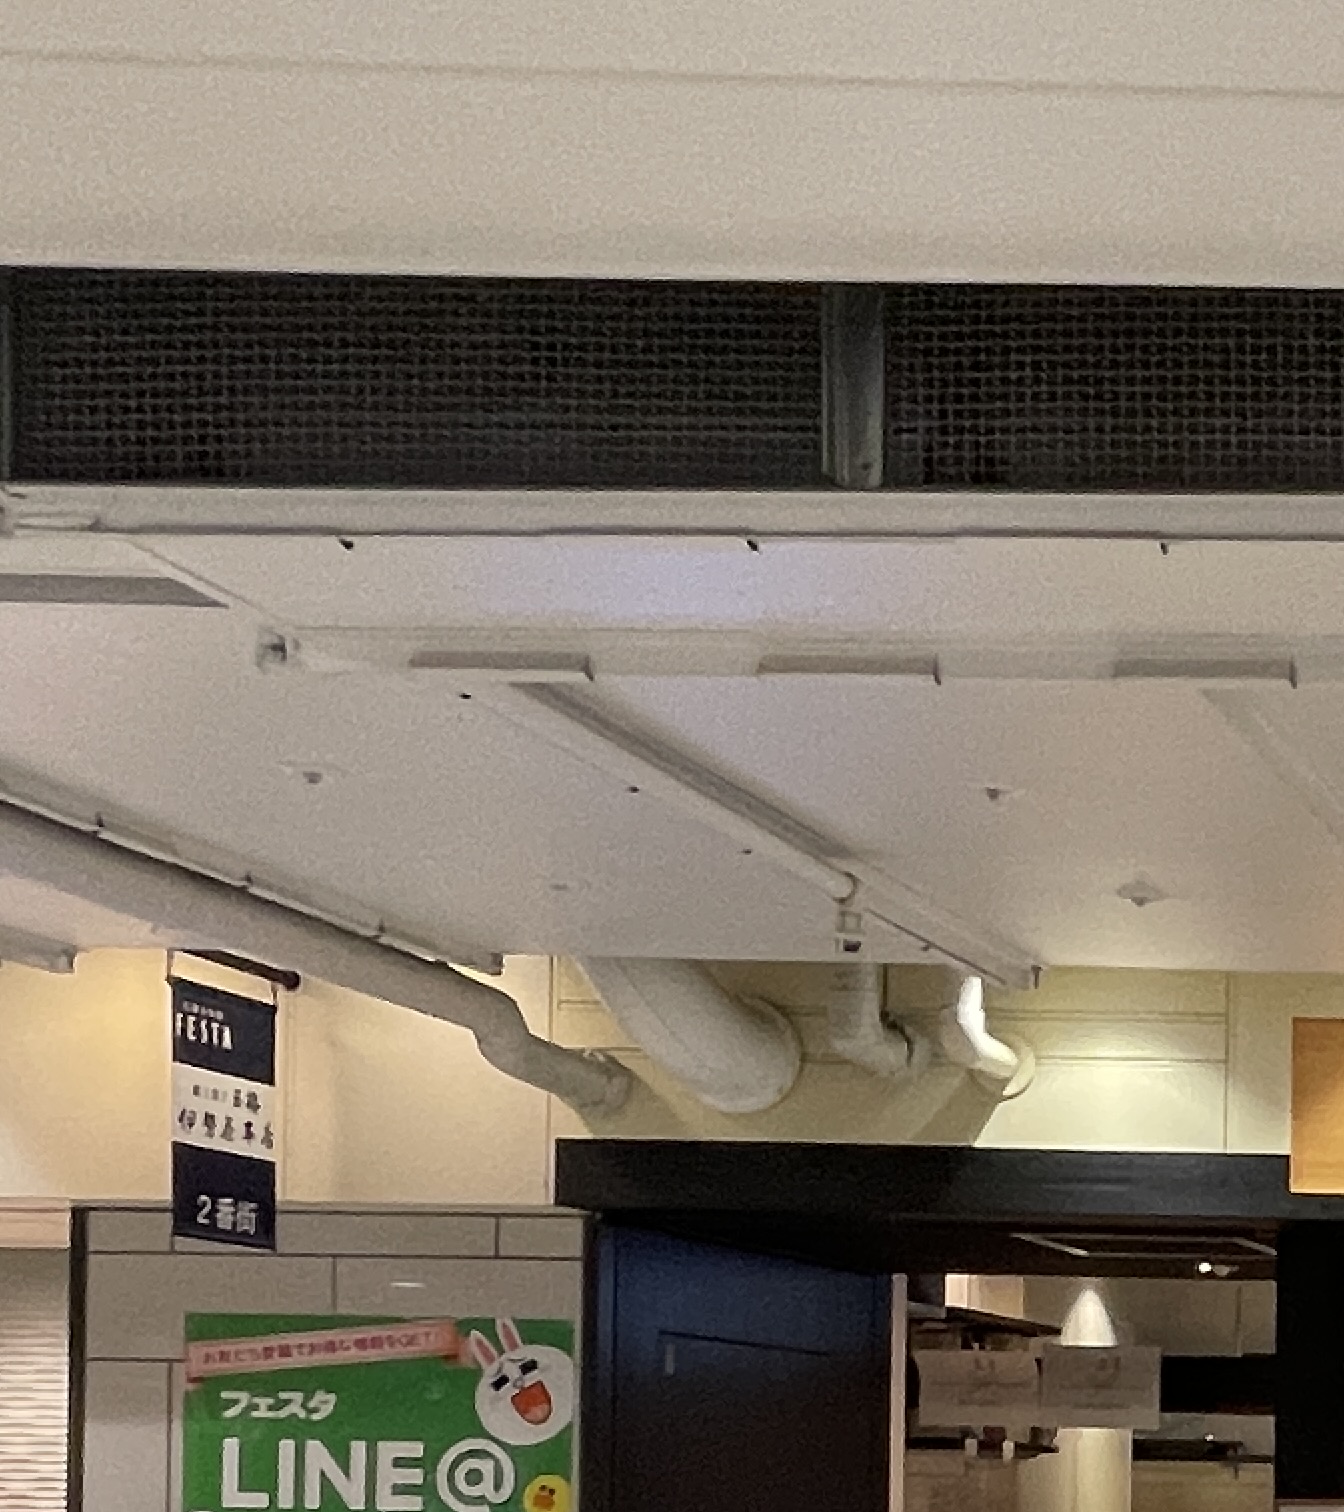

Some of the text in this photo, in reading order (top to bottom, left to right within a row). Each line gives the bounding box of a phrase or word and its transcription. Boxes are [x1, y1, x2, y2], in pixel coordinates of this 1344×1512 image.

[176, 1012, 235, 1051] FESTA
[196, 1193, 259, 1236] 2番街
[219, 1390, 338, 1421] フェスタ
